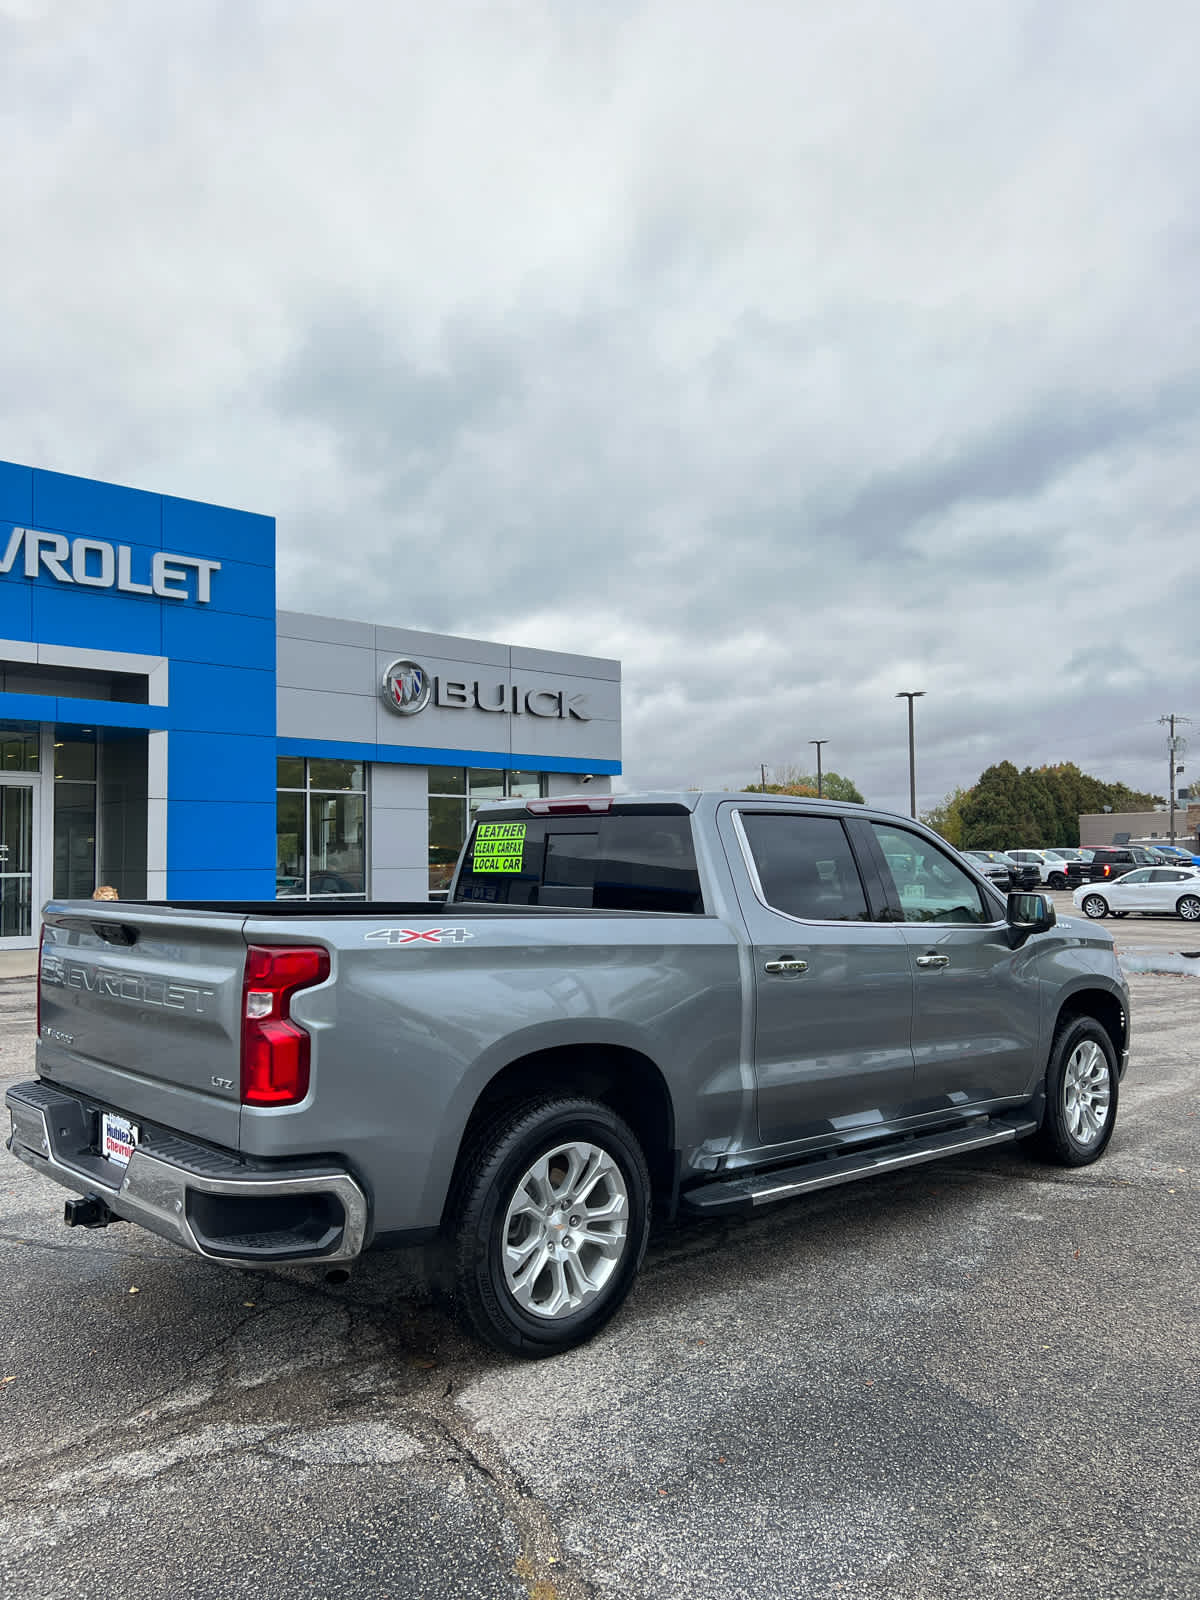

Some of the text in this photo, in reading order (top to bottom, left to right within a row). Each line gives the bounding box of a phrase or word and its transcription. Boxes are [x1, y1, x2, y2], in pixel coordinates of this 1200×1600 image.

[434, 676, 592, 721] BUICK
[477, 825, 525, 838] LEATHER
[475, 841, 522, 854] CLEAN CARFAX
[474, 858, 521, 870] LOCAL CAR
[211, 1076, 233, 1090] LTZ
[106, 1123, 129, 1144] Hubler
